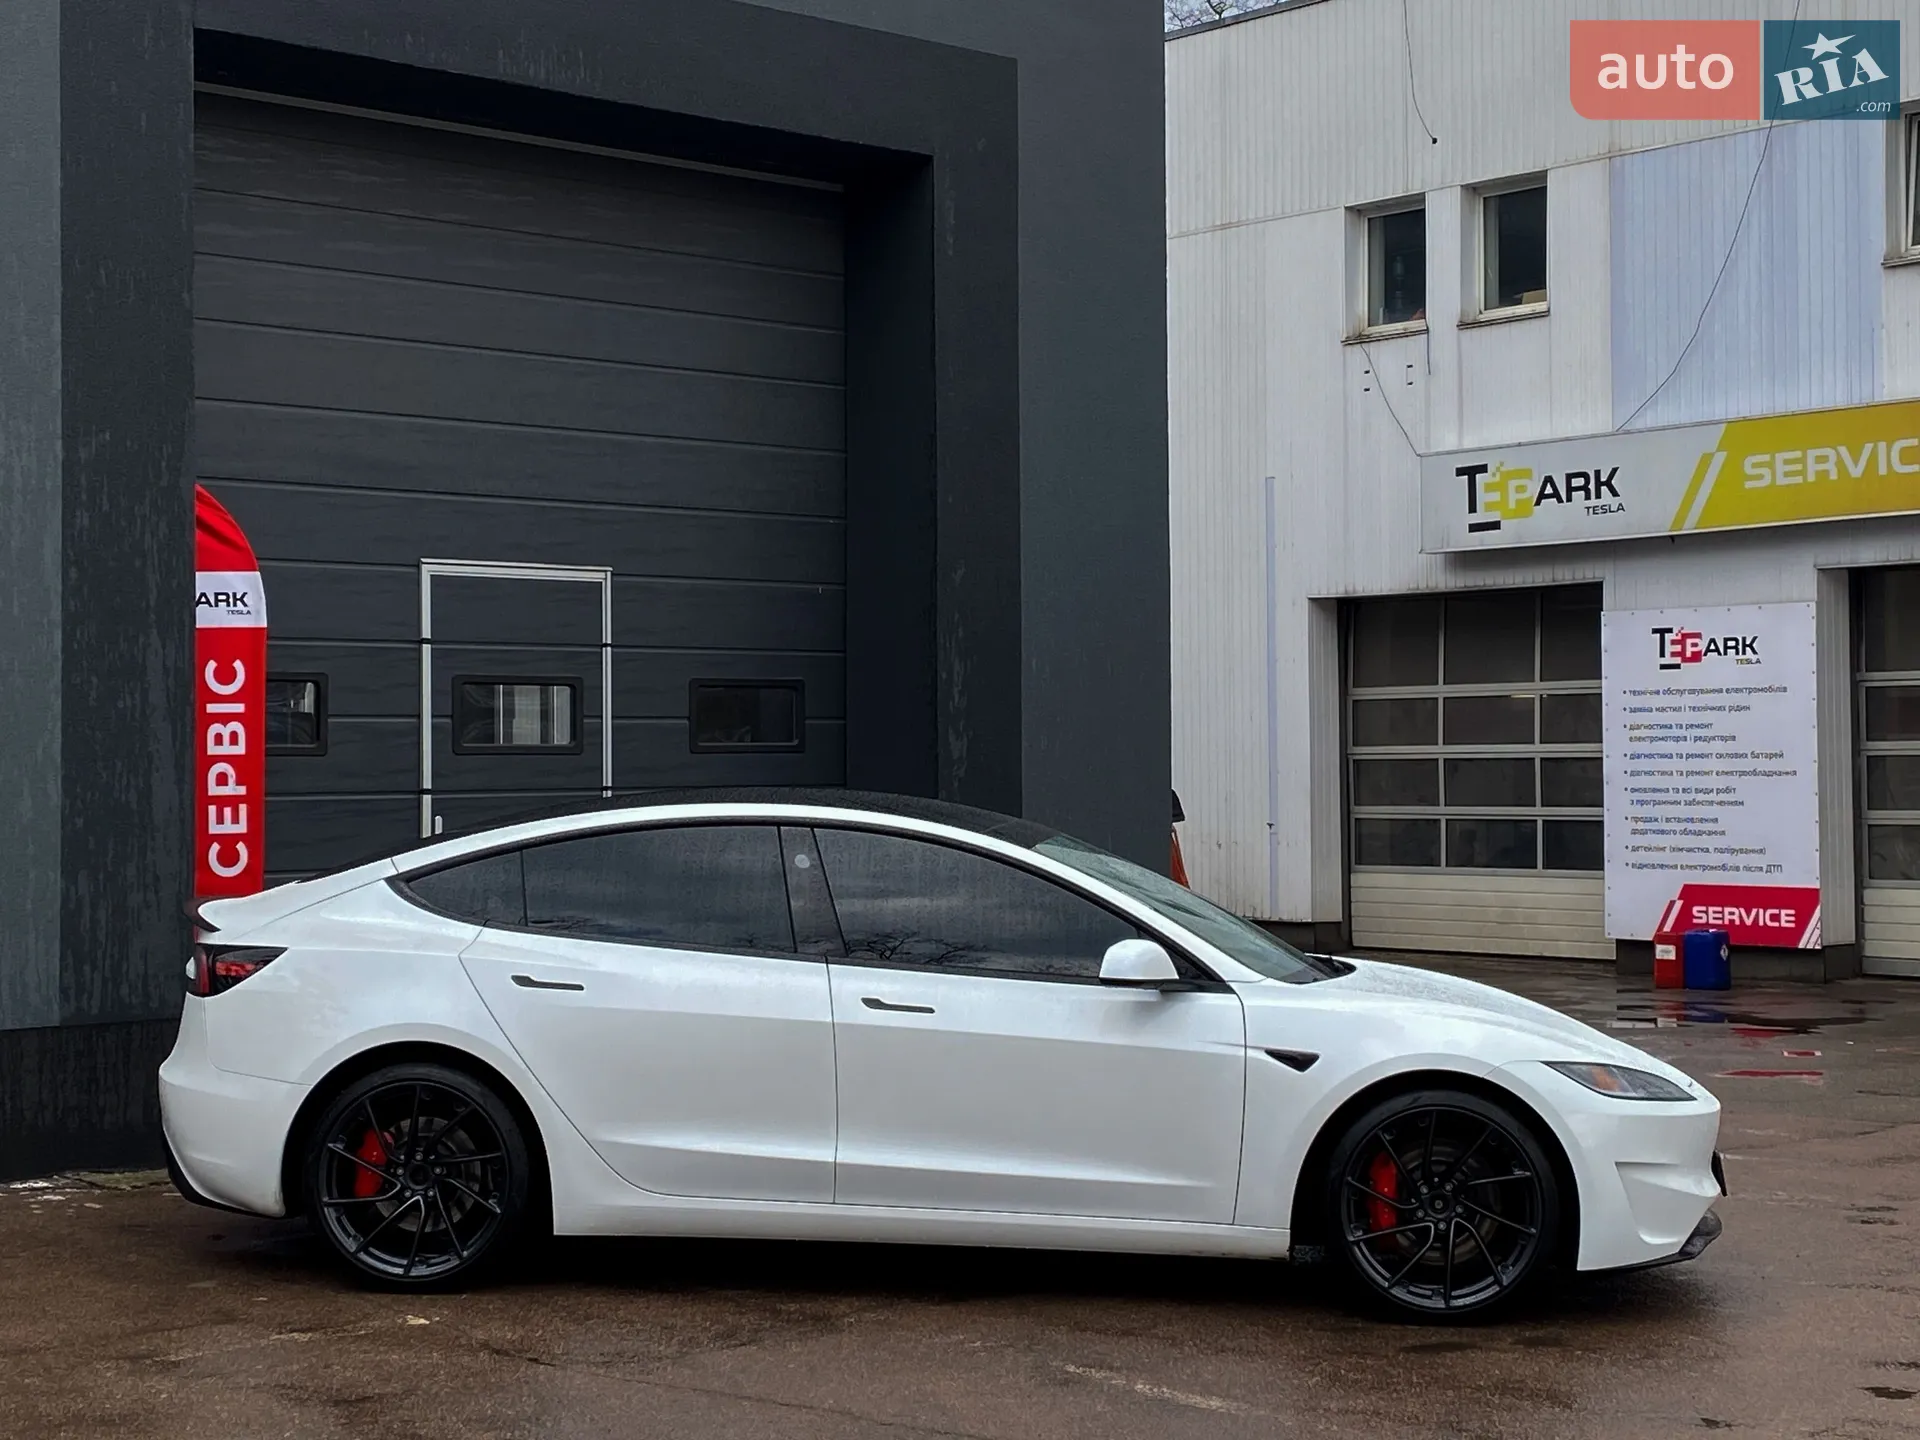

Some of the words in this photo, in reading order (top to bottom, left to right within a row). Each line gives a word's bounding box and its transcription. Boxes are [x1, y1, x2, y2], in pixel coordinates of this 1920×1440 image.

[1584, 502, 1626, 517] TESLA
[1628, 688, 1660, 697] технічне
[1725, 685, 1787, 695] електромобілів
[1655, 705, 1682, 713] мастил
[1688, 704, 1726, 713] технічних
[1728, 704, 1751, 714] рідин
[1628, 723, 1673, 732] діагностика
[1685, 723, 1713, 732] ремонт
[1628, 734, 1688, 743] електромоторів
[1693, 733, 1737, 743] редукторів
[1629, 752, 1674, 760] діагностика
[1675, 752, 1684, 760] та
[1685, 752, 1713, 761] ремонт
[1715, 752, 1749, 760] силових
[1750, 751, 1784, 761] батарей
[204, 659, 248, 878] СЕРВІС
[1629, 769, 1674, 778] діагностика
[1675, 769, 1684, 777] та
[1685, 769, 1714, 779] ремонт
[1671, 786, 1680, 794] та
[1681, 786, 1693, 794] всі
[1694, 787, 1714, 795] види
[1715, 786, 1737, 797] робіт
[1630, 815, 1659, 825] продаж
[1630, 828, 1677, 836] додаткового
[1678, 827, 1727, 837] обладнання
[1631, 862, 1679, 871] відновлення
[1679, 862, 1741, 873] електромобілів
[1742, 863, 1764, 873] після
[1765, 864, 1783, 874] ДТП
[1692, 906, 1796, 928] SERVICE
